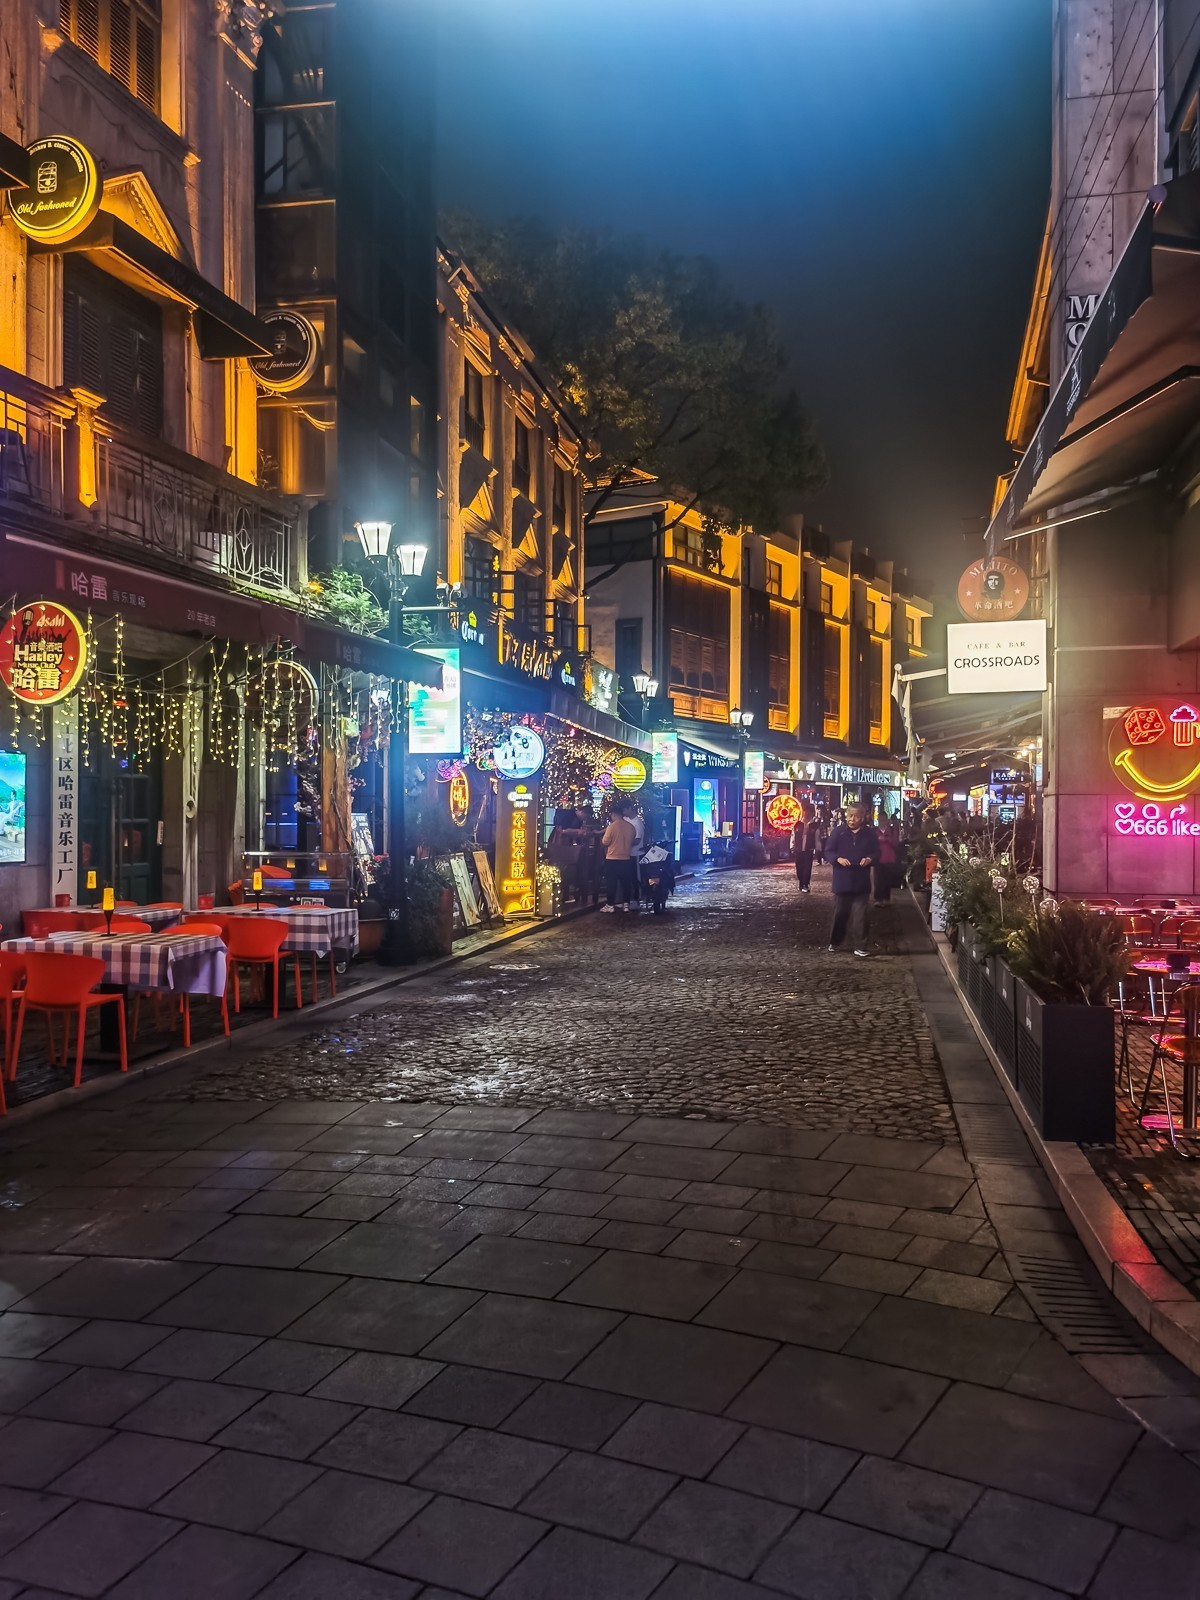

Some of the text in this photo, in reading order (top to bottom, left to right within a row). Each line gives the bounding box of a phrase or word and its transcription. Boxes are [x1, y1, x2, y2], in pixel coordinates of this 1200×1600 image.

[17, 197, 77, 216] Old fashioned
[70, 571, 108, 601] 哈雷
[974, 600, 1014, 610] 革命酒吧
[14, 644, 63, 665] Harley
[967, 642, 990, 650] CAFE
[953, 654, 1040, 669] CROSSROADS
[13, 667, 62, 690] 哈雷
[1134, 819, 1168, 835] 666
